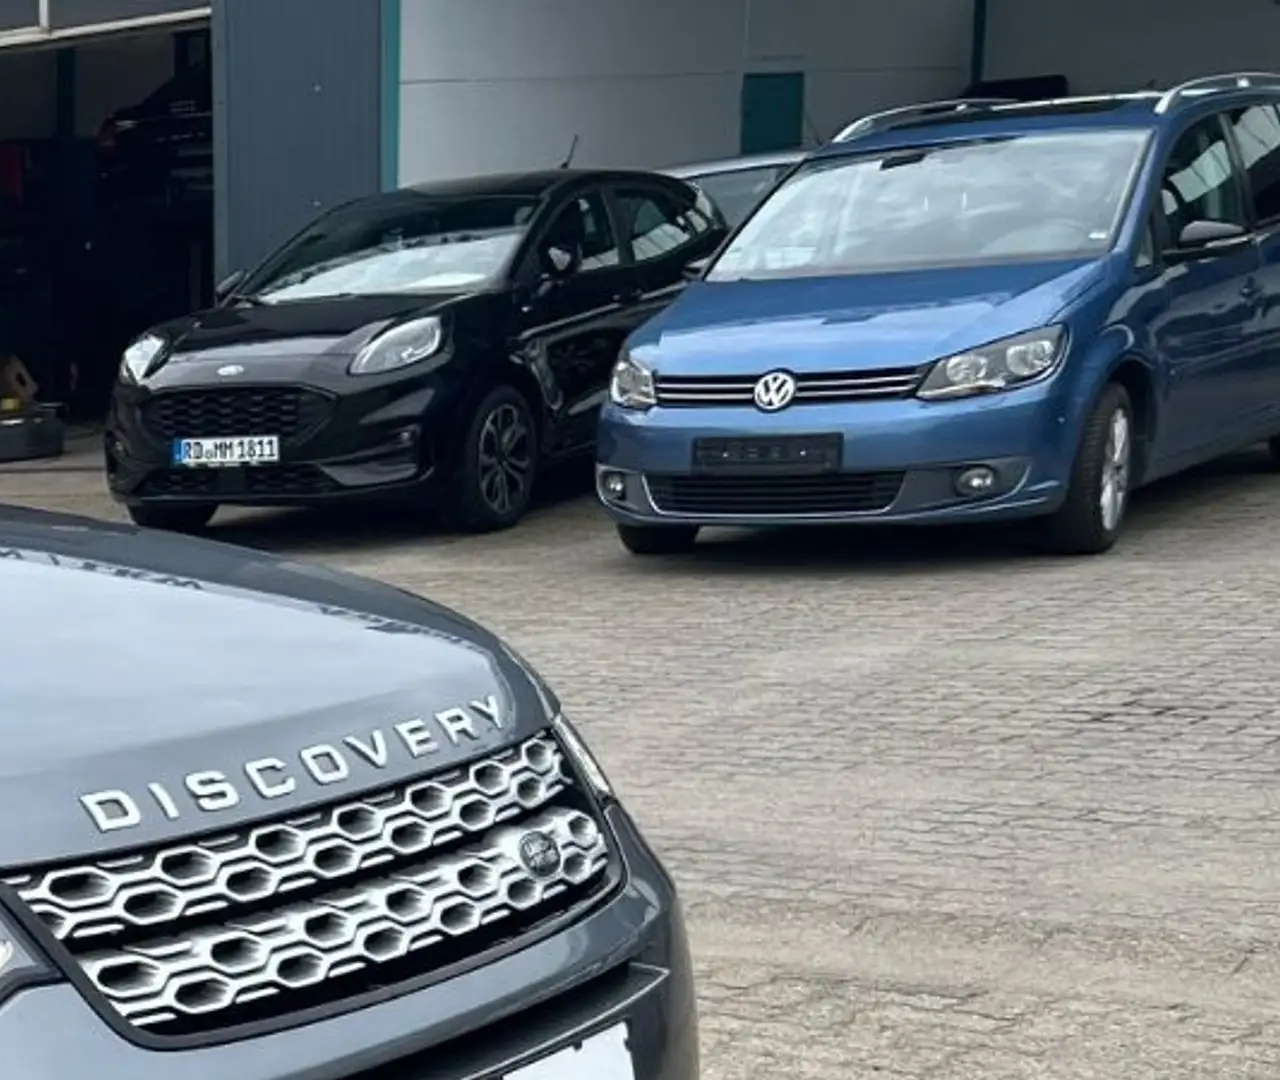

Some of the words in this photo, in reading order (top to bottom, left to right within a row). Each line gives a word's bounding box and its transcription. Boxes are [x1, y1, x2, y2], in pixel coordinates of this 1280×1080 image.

[754, 370, 795, 411] VW
[183, 441, 203, 460] RD
[238, 439, 276, 459] 1811
[79, 694, 503, 832] DISCOVERY
